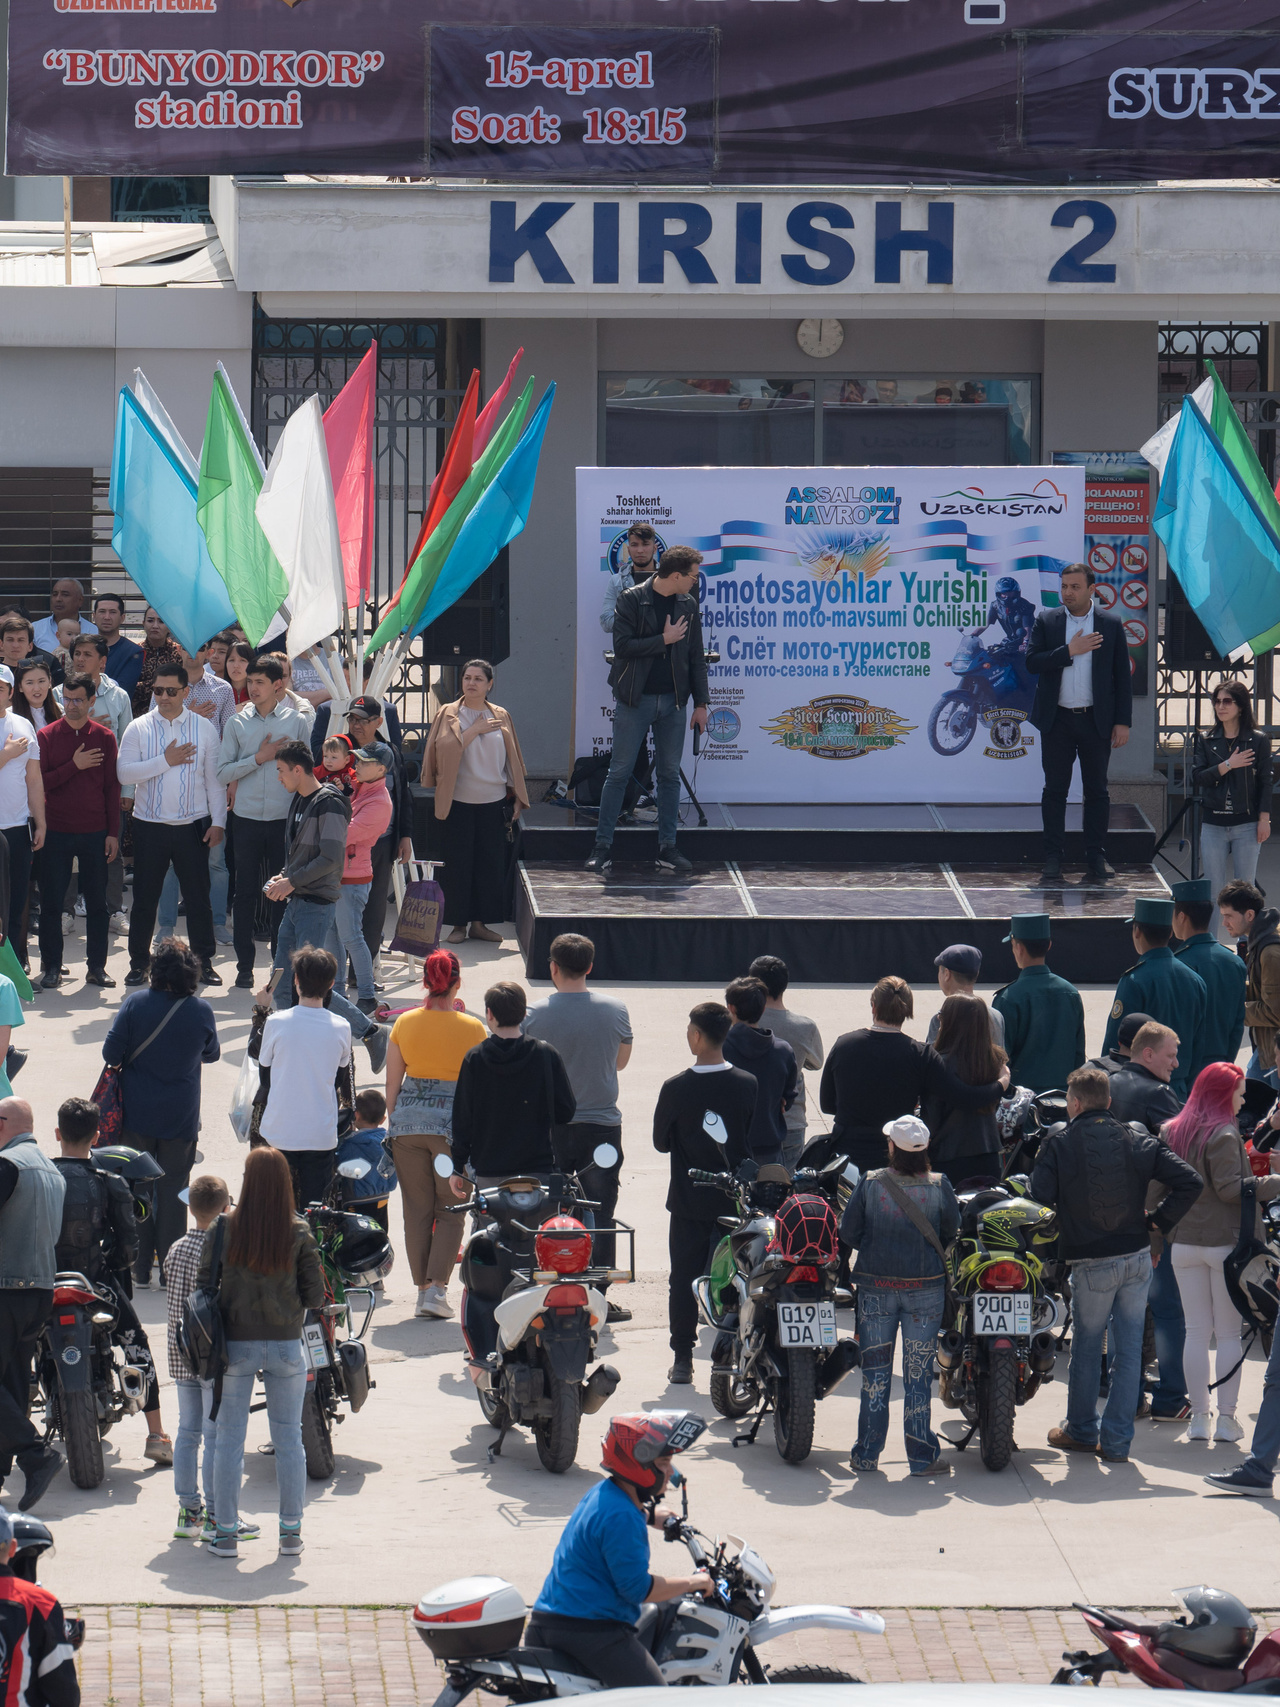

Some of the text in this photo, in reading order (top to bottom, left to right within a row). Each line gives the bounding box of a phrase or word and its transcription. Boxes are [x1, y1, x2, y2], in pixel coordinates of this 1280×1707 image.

[486, 49, 654, 95] 15-aprel
[135, 90, 303, 129] stadioni
[451, 106, 687, 145] Soat: 18:15
[489, 199, 1117, 286] KIRISH 2
[616, 495, 661, 507] Toshkent
[785, 486, 902, 505] ASSALOM,
[606, 507, 673, 517] shahar hokimligi
[919, 501, 1063, 517] UZBEKISTAN
[901, 570, 988, 604] Yurishi
[783, 605, 907, 628] moto-mavsumi
[913, 604, 987, 628] Ochilishi
[727, 635, 776, 660] Слёт
[783, 641, 931, 667] мото-туристов
[745, 665, 827, 677] мото-сезона
[832, 665, 840, 677] в
[844, 661, 931, 677] Узбекистане
[793, 707, 891, 726] Steel Scorpions
[805, 733, 828, 747] Слёт
[830, 735, 895, 749] мототуристов
[982, 1210, 1027, 1218] sparco
[977, 1296, 1029, 1313] 900 10
[781, 1306, 833, 1323] 019 01
[982, 1315, 1008, 1332] AA
[307, 1331, 321, 1341] 01
[787, 1326, 814, 1343] DA
[315, 1357, 325, 1365] UZ
